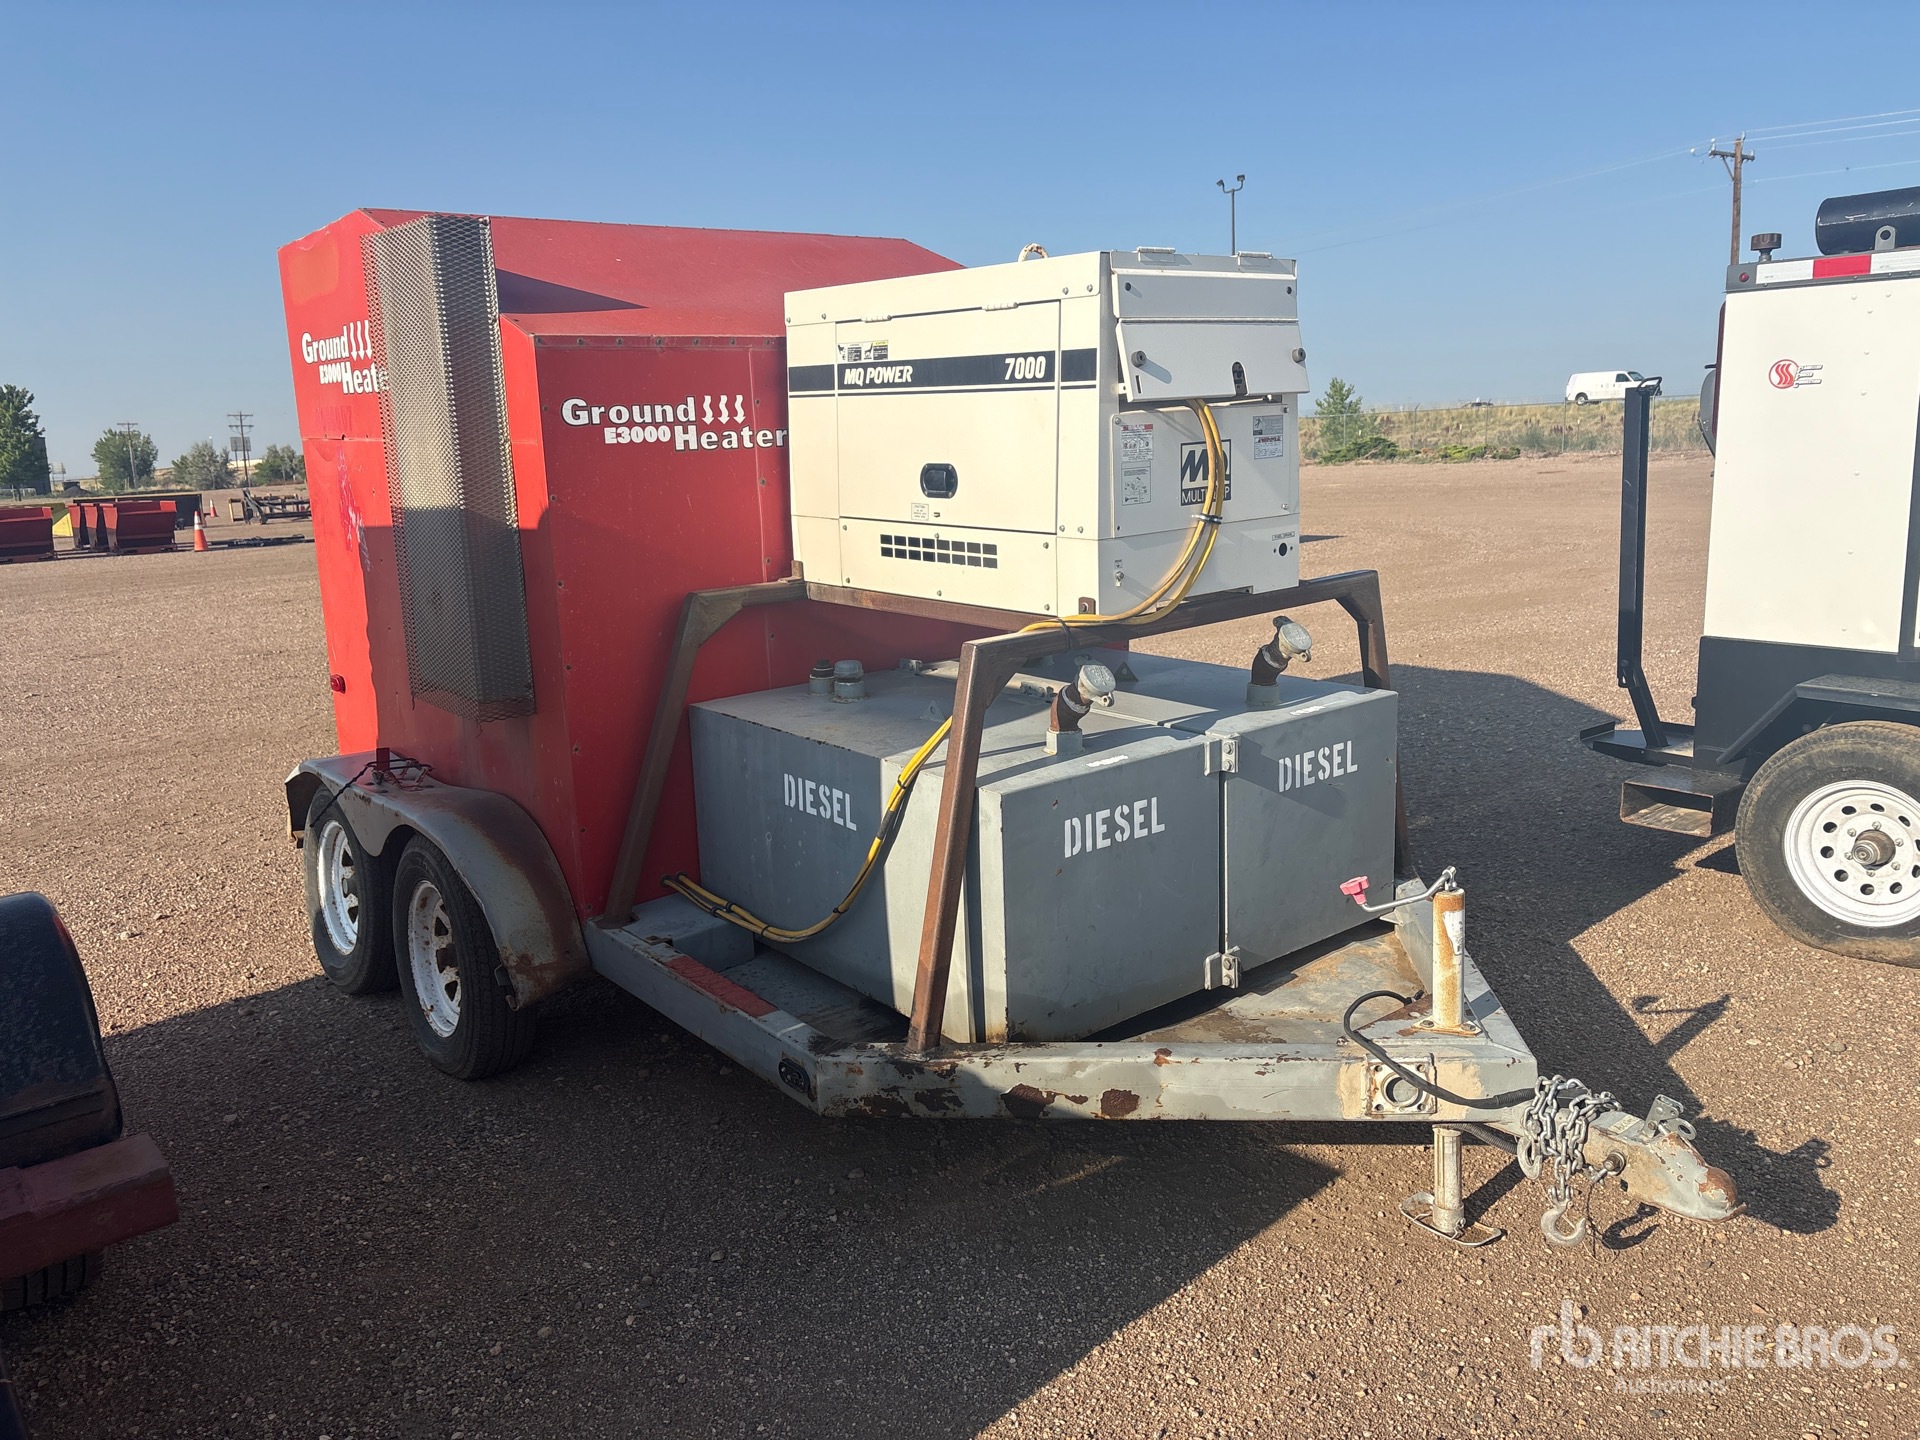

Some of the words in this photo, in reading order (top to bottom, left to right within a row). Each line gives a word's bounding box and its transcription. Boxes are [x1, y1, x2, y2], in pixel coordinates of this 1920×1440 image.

[302, 325, 349, 363] Ground
[844, 367, 864, 386] MQ
[866, 365, 913, 385] POWER
[1004, 355, 1046, 381] 7000
[561, 395, 697, 427] Ground
[604, 425, 671, 444] E3000
[674, 424, 788, 451] Heater
[1277, 739, 1359, 794] DIESEL
[783, 772, 858, 832] DIESEL
[1063, 796, 1166, 859] DIESEL
